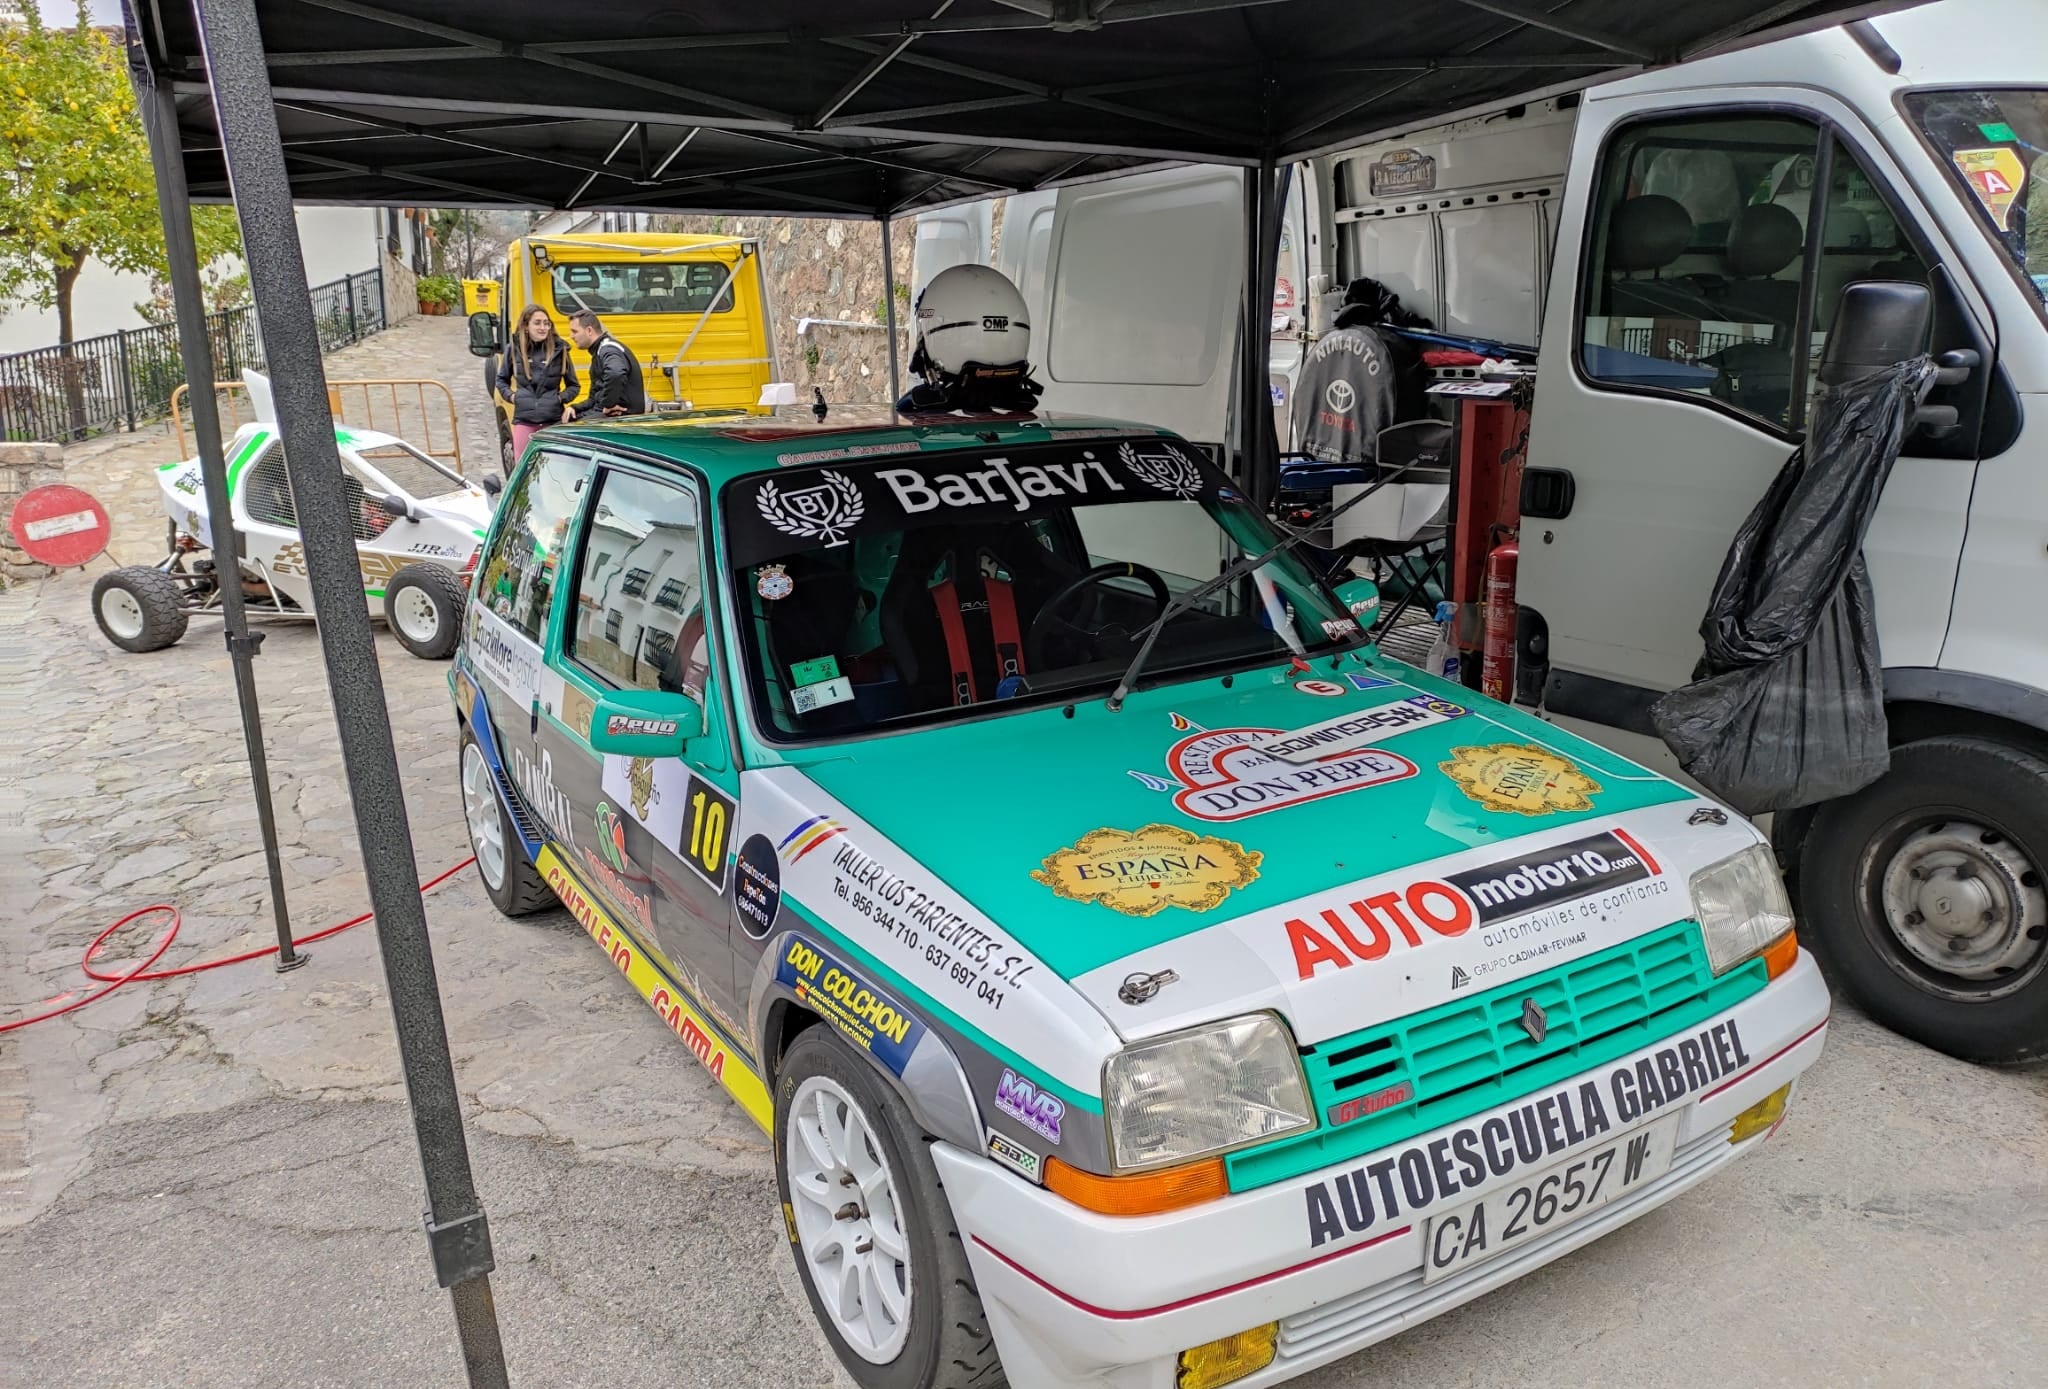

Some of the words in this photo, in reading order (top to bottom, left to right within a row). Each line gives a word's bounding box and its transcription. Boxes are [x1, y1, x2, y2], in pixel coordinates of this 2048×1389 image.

[982, 318, 1009, 329] OMP
[875, 451, 1123, 514] BarJavi
[1151, 452, 1175, 476] BJ
[796, 489, 830, 518] BJ
[407, 543, 441, 555] JJR
[828, 685, 837, 698] 1
[1188, 730, 1277, 776] RESTAURA
[1198, 774, 1300, 812] DON
[1298, 756, 1394, 788] PEPE
[1491, 756, 1544, 800] ESPAÑA
[691, 791, 726, 873] 10
[1088, 846, 1136, 861] EMBUTIDOS
[738, 854, 779, 894] Construcciones
[1074, 852, 1220, 881] ESPAÑA
[832, 842, 885, 892] TALLER
[877, 873, 916, 907] LOS
[905, 892, 1004, 972] PARIENTES,
[993, 955, 1035, 990] S.L.
[1483, 905, 1575, 948] automóviles
[1579, 900, 1598, 918] de
[1603, 880, 1669, 912] confianza
[833, 877, 850, 902] Tel.
[852, 891, 872, 916] 956
[873, 907, 896, 933] 344
[895, 922, 919, 950] 710
[925, 944, 951, 971] 637
[950, 961, 978, 990] 697
[976, 980, 1006, 1010] 041
[1473, 956, 1507, 977] GRUPO
[1507, 931, 1588, 965] CADIMAR-FEVIMAR
[786, 941, 825, 981] DON
[822, 967, 912, 1045] COLCHON
[807, 995, 839, 1026] PRODUCTO
[838, 1021, 872, 1052] NACIONAL
[997, 1071, 1063, 1132] MVR
[1340, 1099, 1361, 1123] GT
[1364, 1088, 1405, 1114] turbo
[1305, 1080, 1609, 1249] AUTOESCUELA
[1608, 1018, 1750, 1125] GABRIEL
[1432, 1211, 1487, 1269] CA
[1501, 1146, 1617, 1242] 2657
[1622, 1130, 1651, 1187] W
